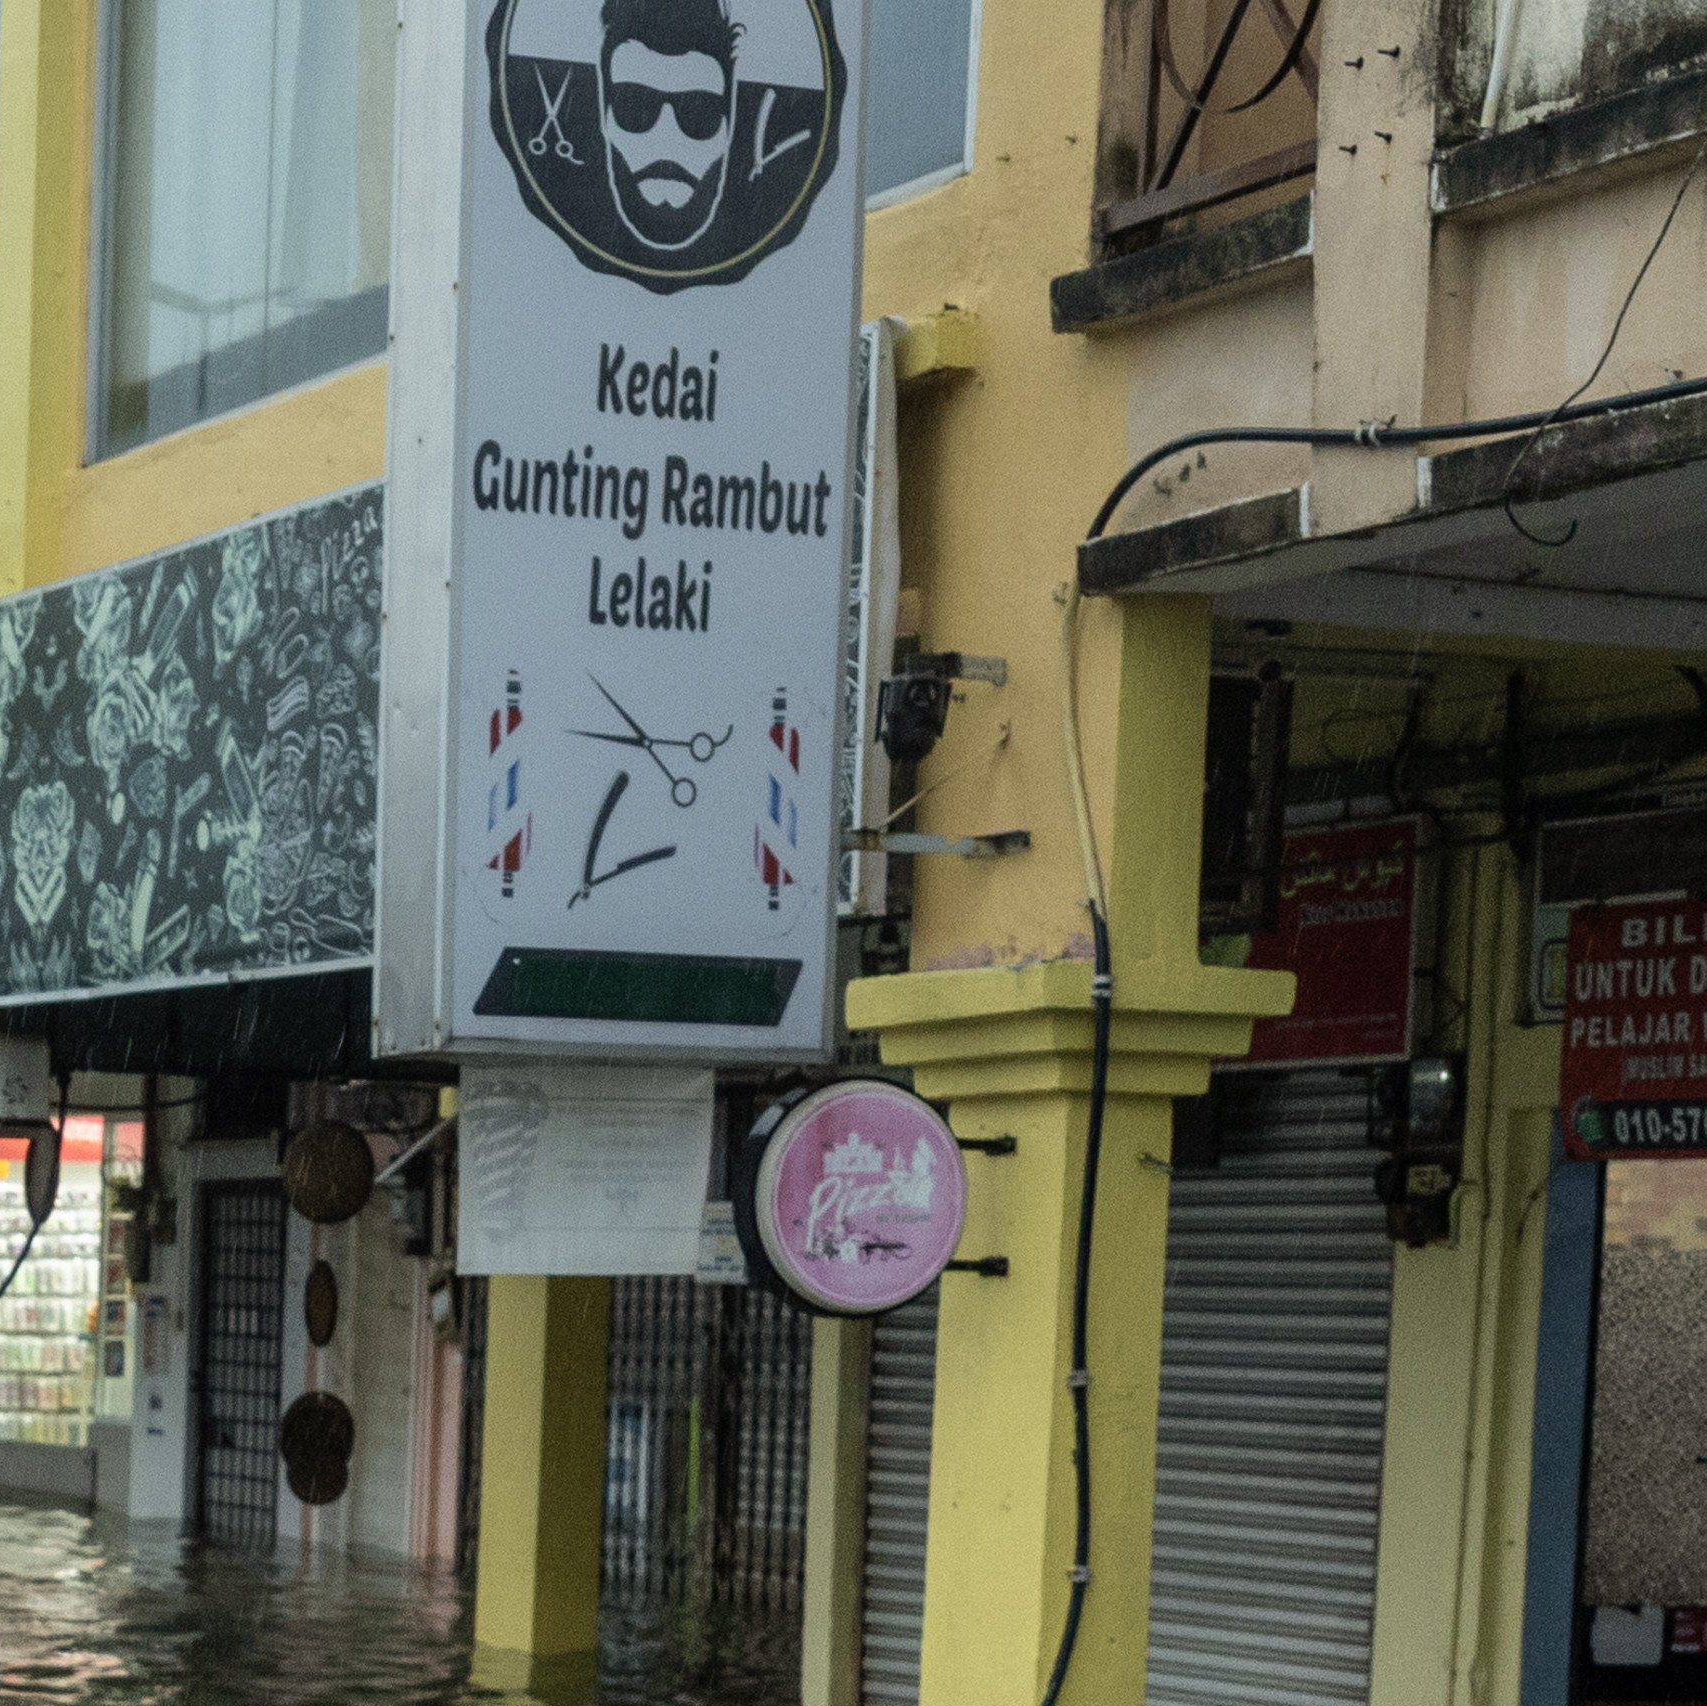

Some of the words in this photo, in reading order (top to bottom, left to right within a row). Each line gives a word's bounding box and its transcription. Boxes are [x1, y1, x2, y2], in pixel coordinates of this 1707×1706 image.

[597, 342, 718, 422] Kedai
[472, 439, 648, 540] Gunting
[663, 454, 832, 538] Rambut
[588, 556, 712, 633] Lelaki
[1621, 914, 1707, 948] BIL
[1574, 958, 1677, 1001] UNTUK
[1570, 1010, 1691, 1049] PELAJAR
[1613, 1105, 1707, 1144] 010-57
